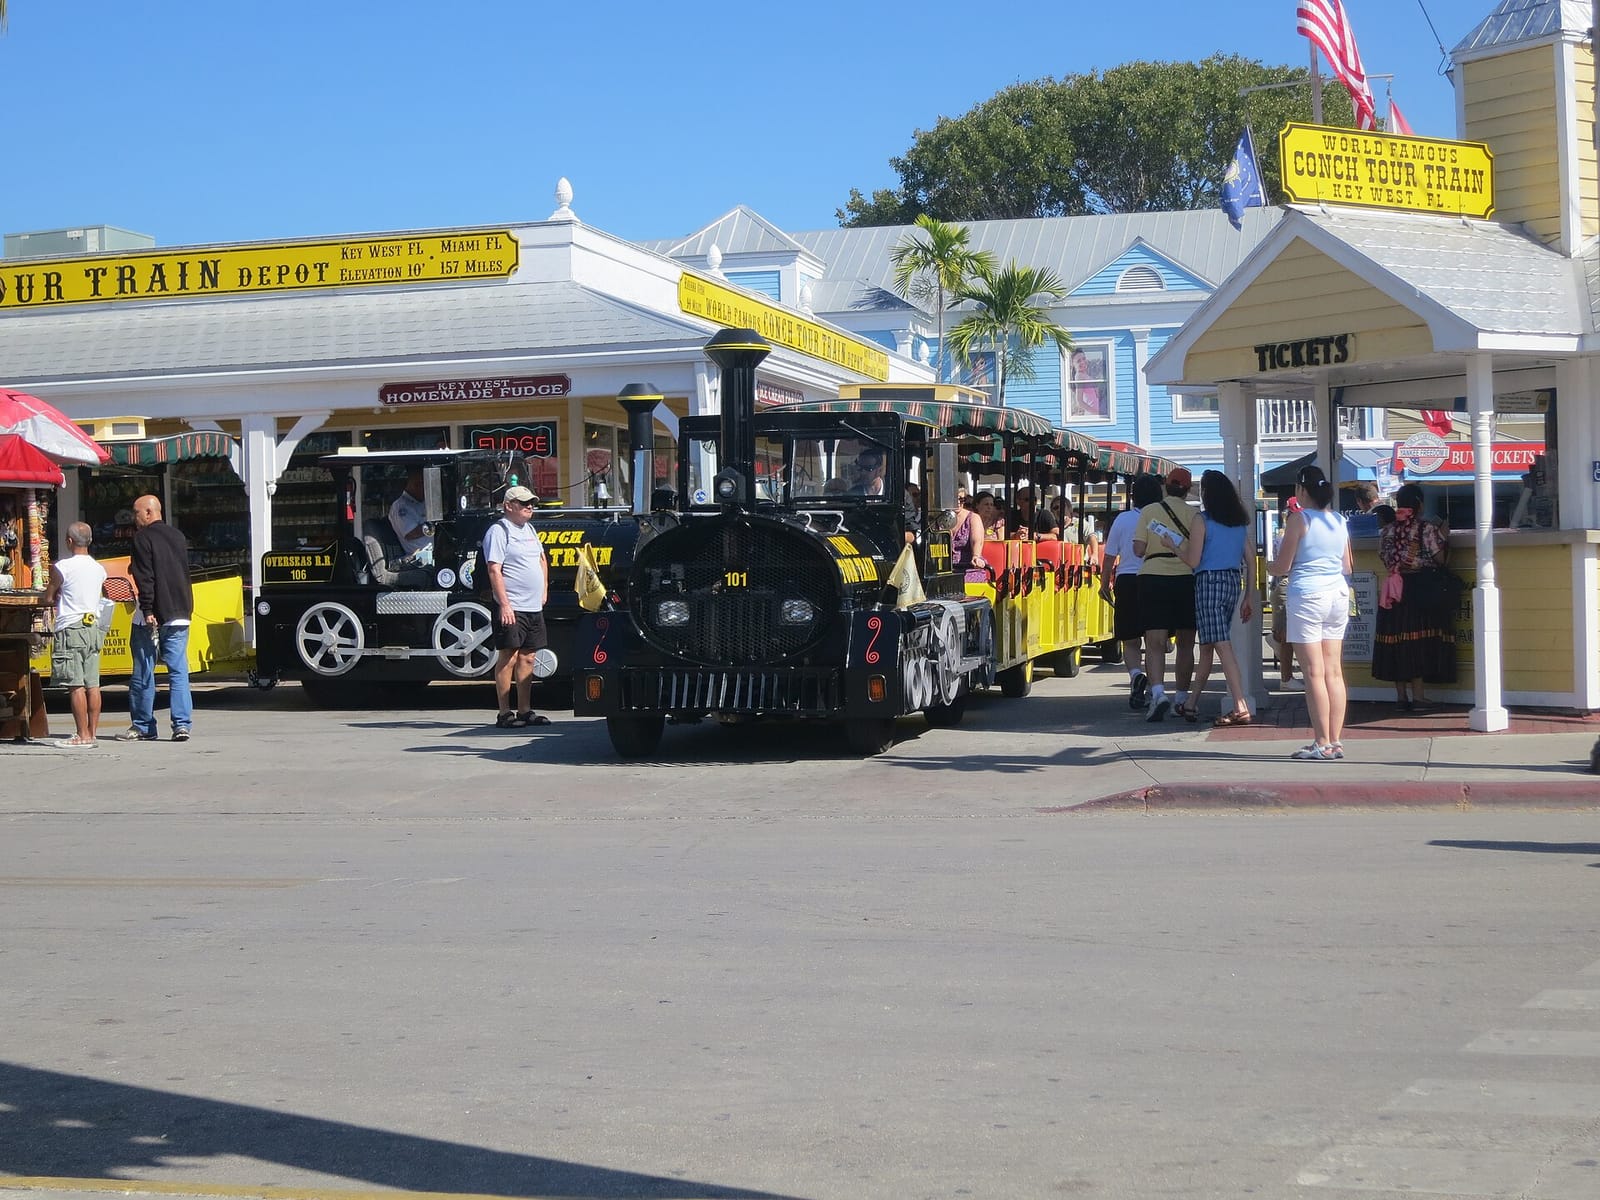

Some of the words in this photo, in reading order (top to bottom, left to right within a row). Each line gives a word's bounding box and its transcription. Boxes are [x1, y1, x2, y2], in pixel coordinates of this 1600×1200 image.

[1322, 135, 1383, 155] WORLD
[1389, 142, 1457, 163] FAMOUS
[1294, 151, 1359, 182] CONCH
[1365, 158, 1418, 188] TOUR
[1424, 164, 1484, 194] TRAIN
[1333, 183, 1363, 199] KEY
[341, 247, 363, 260] KEY
[369, 244, 402, 258] WEST
[408, 241, 424, 255] FL
[441, 240, 480, 253] MIAMI
[486, 237, 502, 250] FL
[340, 267, 402, 281] ELEVATION
[440, 261, 460, 274] 157
[465, 259, 503, 273] MILES
[84, 259, 221, 297] TRAIN
[238, 262, 329, 287] DEPOT
[706, 297, 732, 322] WORLD
[734, 306, 761, 333] FAMOUS
[763, 311, 793, 344] CONCH
[796, 323, 819, 353] TOUR
[822, 333, 847, 363] TRAIN
[1254, 334, 1349, 371] TICKETS
[438, 382, 467, 391] KEY
[472, 379, 510, 389] WEST
[386, 388, 493, 404] HOMEMADE
[500, 384, 563, 397] FUDGE
[479, 436, 547, 452] FUDGE
[1491, 450, 1536, 464] ICKETS
[266, 556, 312, 567] OVERSEAS
[290, 569, 307, 580] 106
[725, 572, 747, 587] 101
[103, 638, 126, 647] OLONY
[103, 647, 126, 656] BEACH
